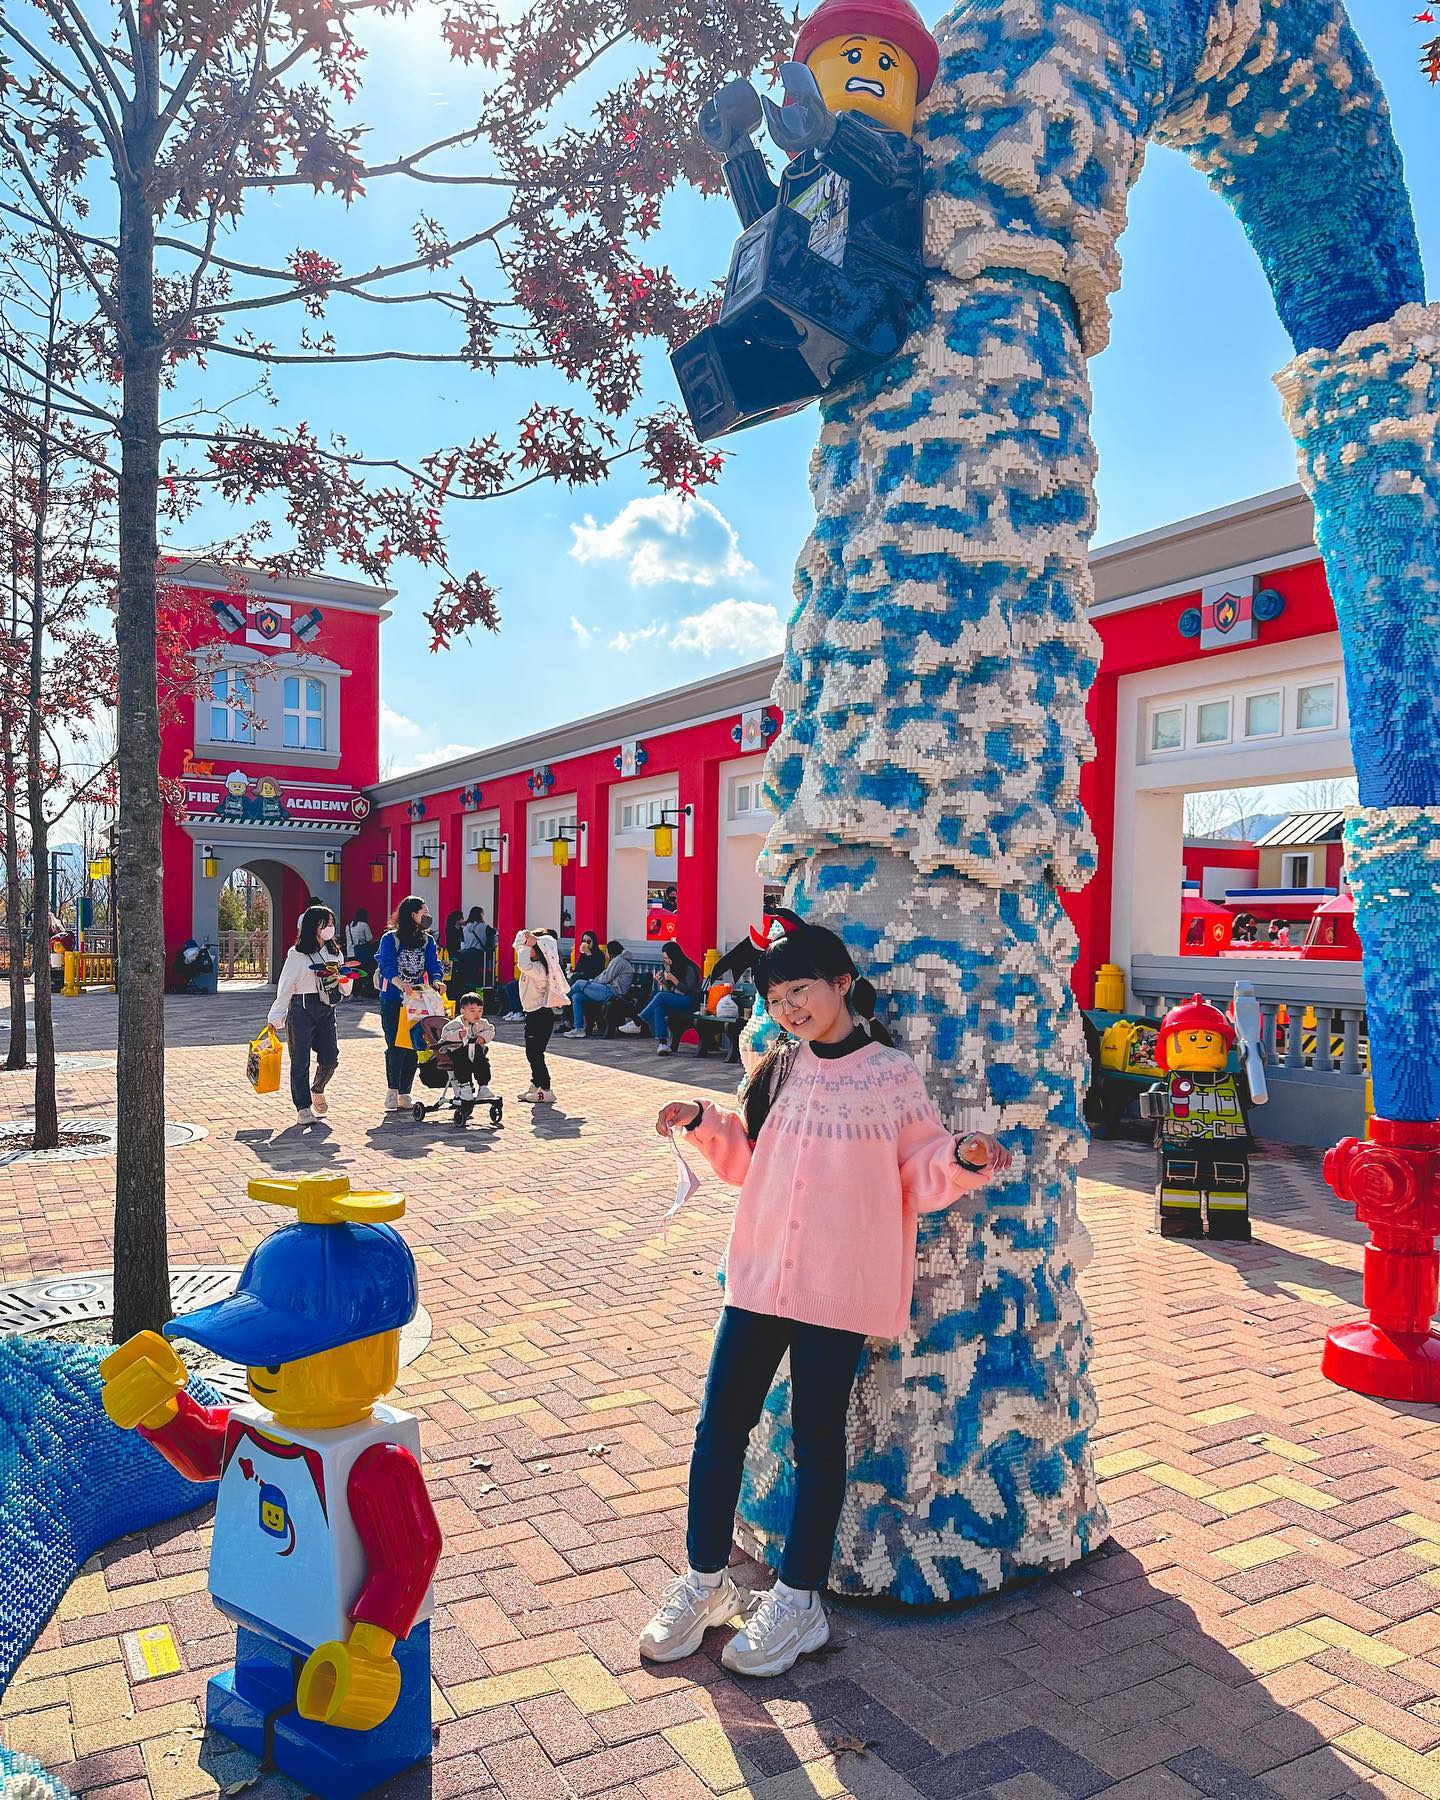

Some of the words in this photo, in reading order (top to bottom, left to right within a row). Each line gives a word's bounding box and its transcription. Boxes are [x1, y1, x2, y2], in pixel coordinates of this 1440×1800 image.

[188, 791, 220, 804] FIRE
[286, 798, 349, 812] ACADEMY
[537, 1091, 545, 1101] B
